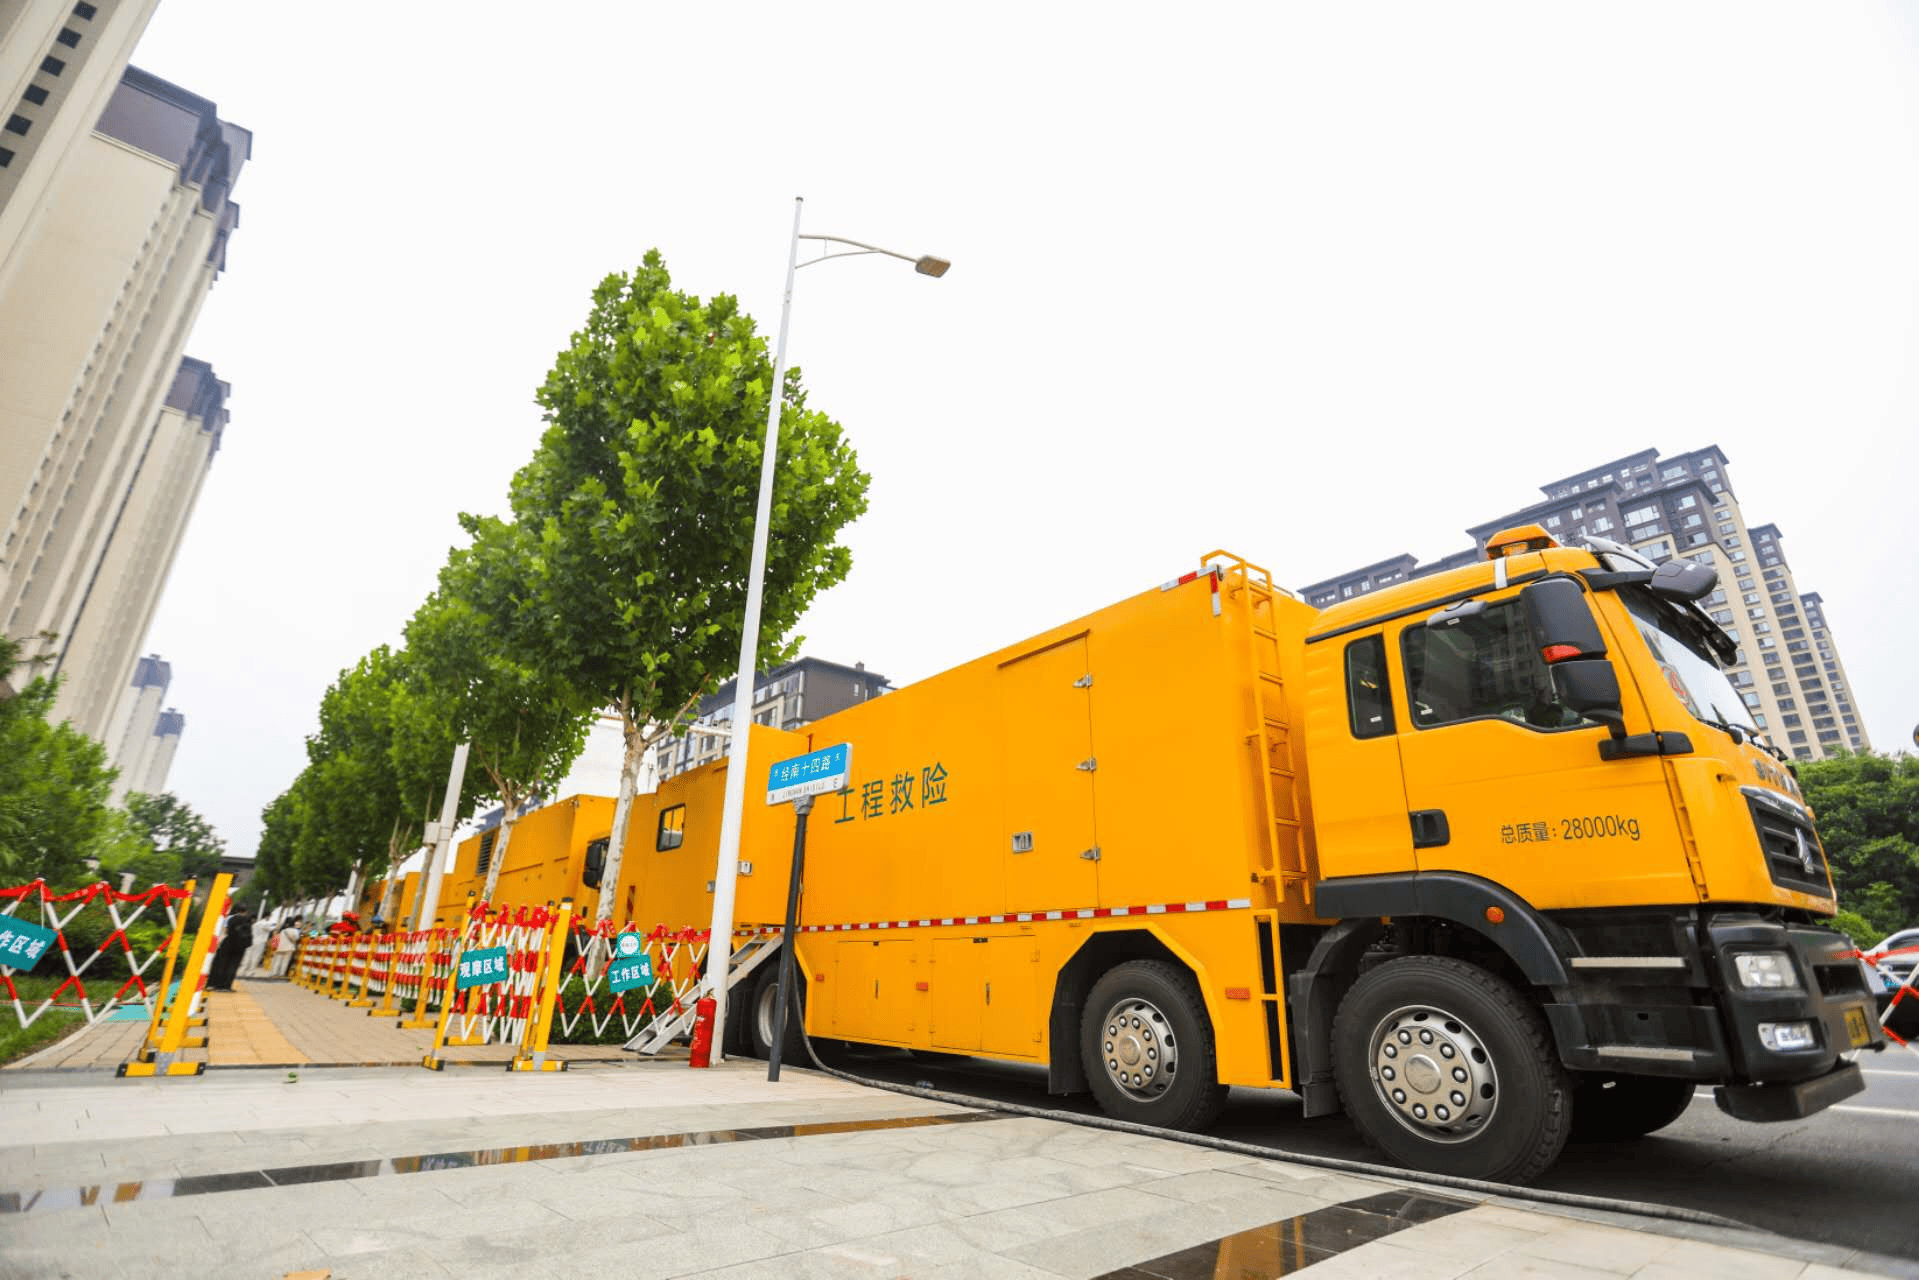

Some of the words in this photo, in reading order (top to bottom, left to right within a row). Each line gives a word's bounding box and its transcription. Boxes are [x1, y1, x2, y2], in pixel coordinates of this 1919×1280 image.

[834, 761, 949, 824] 工程救险
[611, 962, 651, 984] 工作区域
